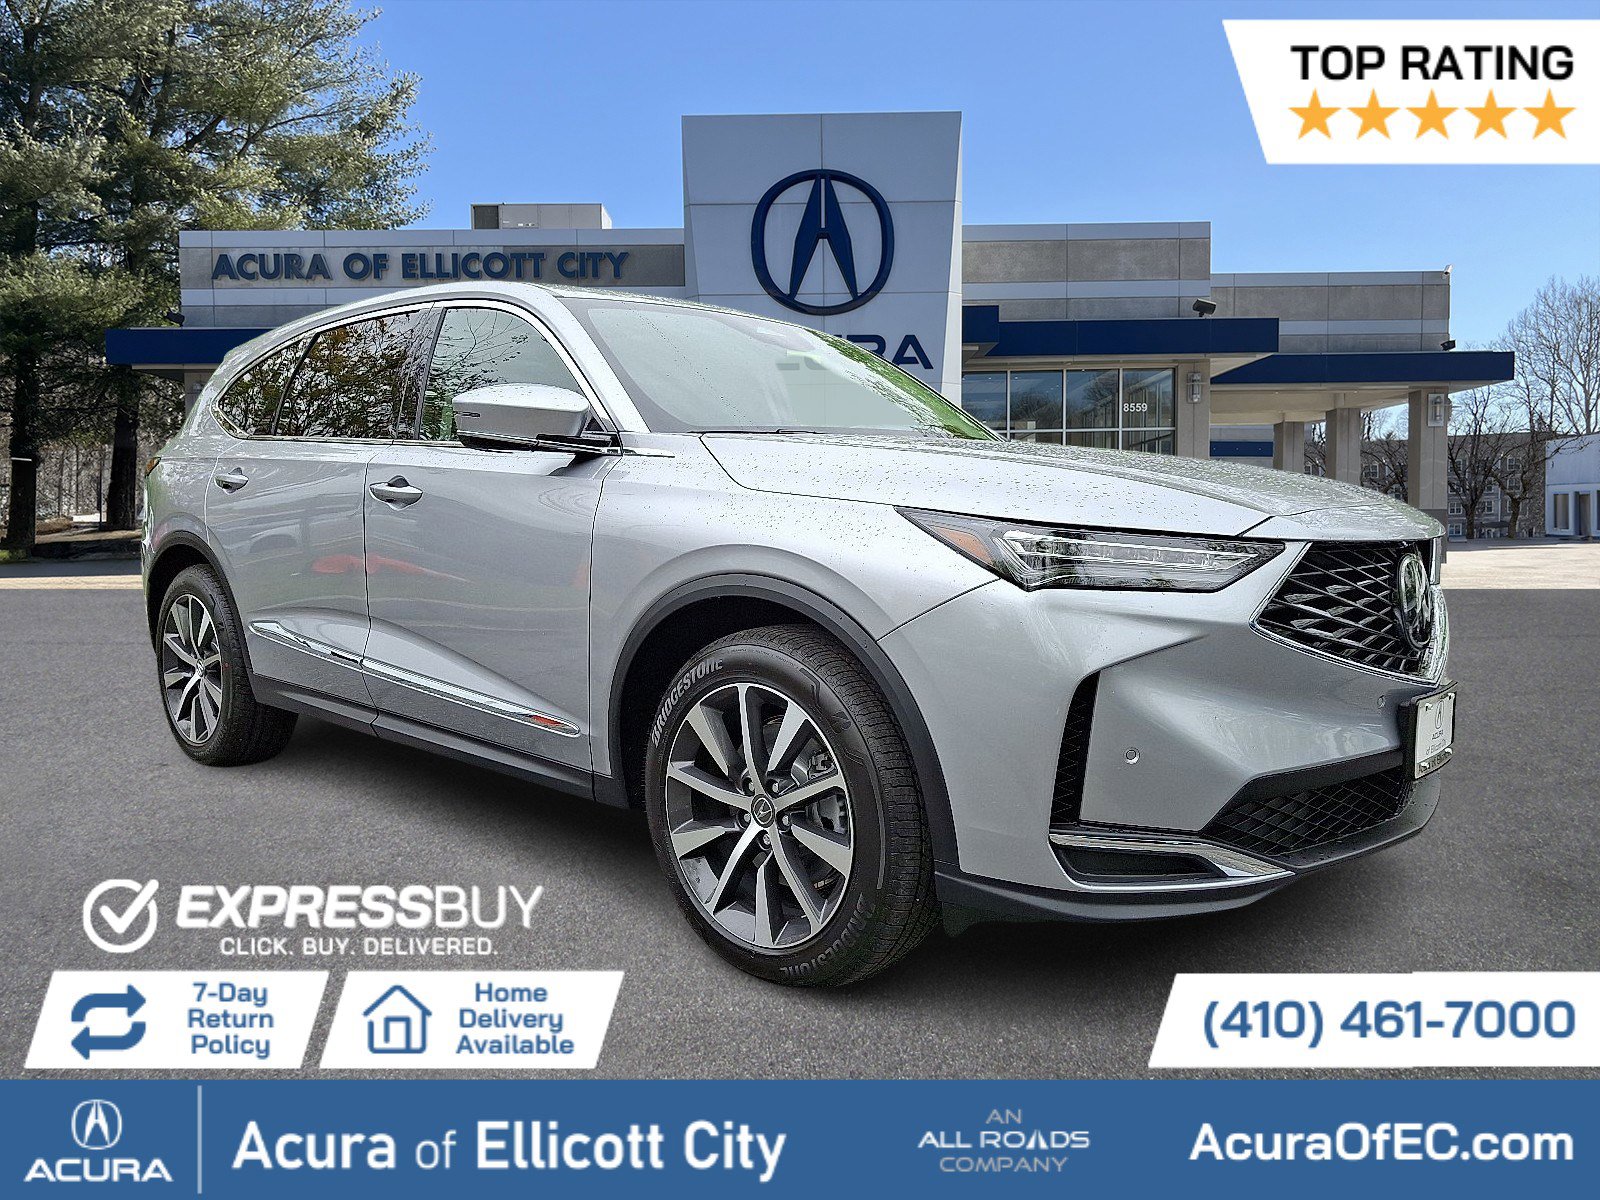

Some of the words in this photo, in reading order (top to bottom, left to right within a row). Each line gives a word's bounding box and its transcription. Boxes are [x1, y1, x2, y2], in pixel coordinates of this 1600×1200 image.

[212, 253, 332, 280] ACURA
[342, 252, 390, 280] OF
[401, 252, 547, 280] ELLICOTT
[556, 251, 629, 279] CITY
[1123, 403, 1148, 412] 8559
[651, 658, 724, 748] BRIDGESTONE
